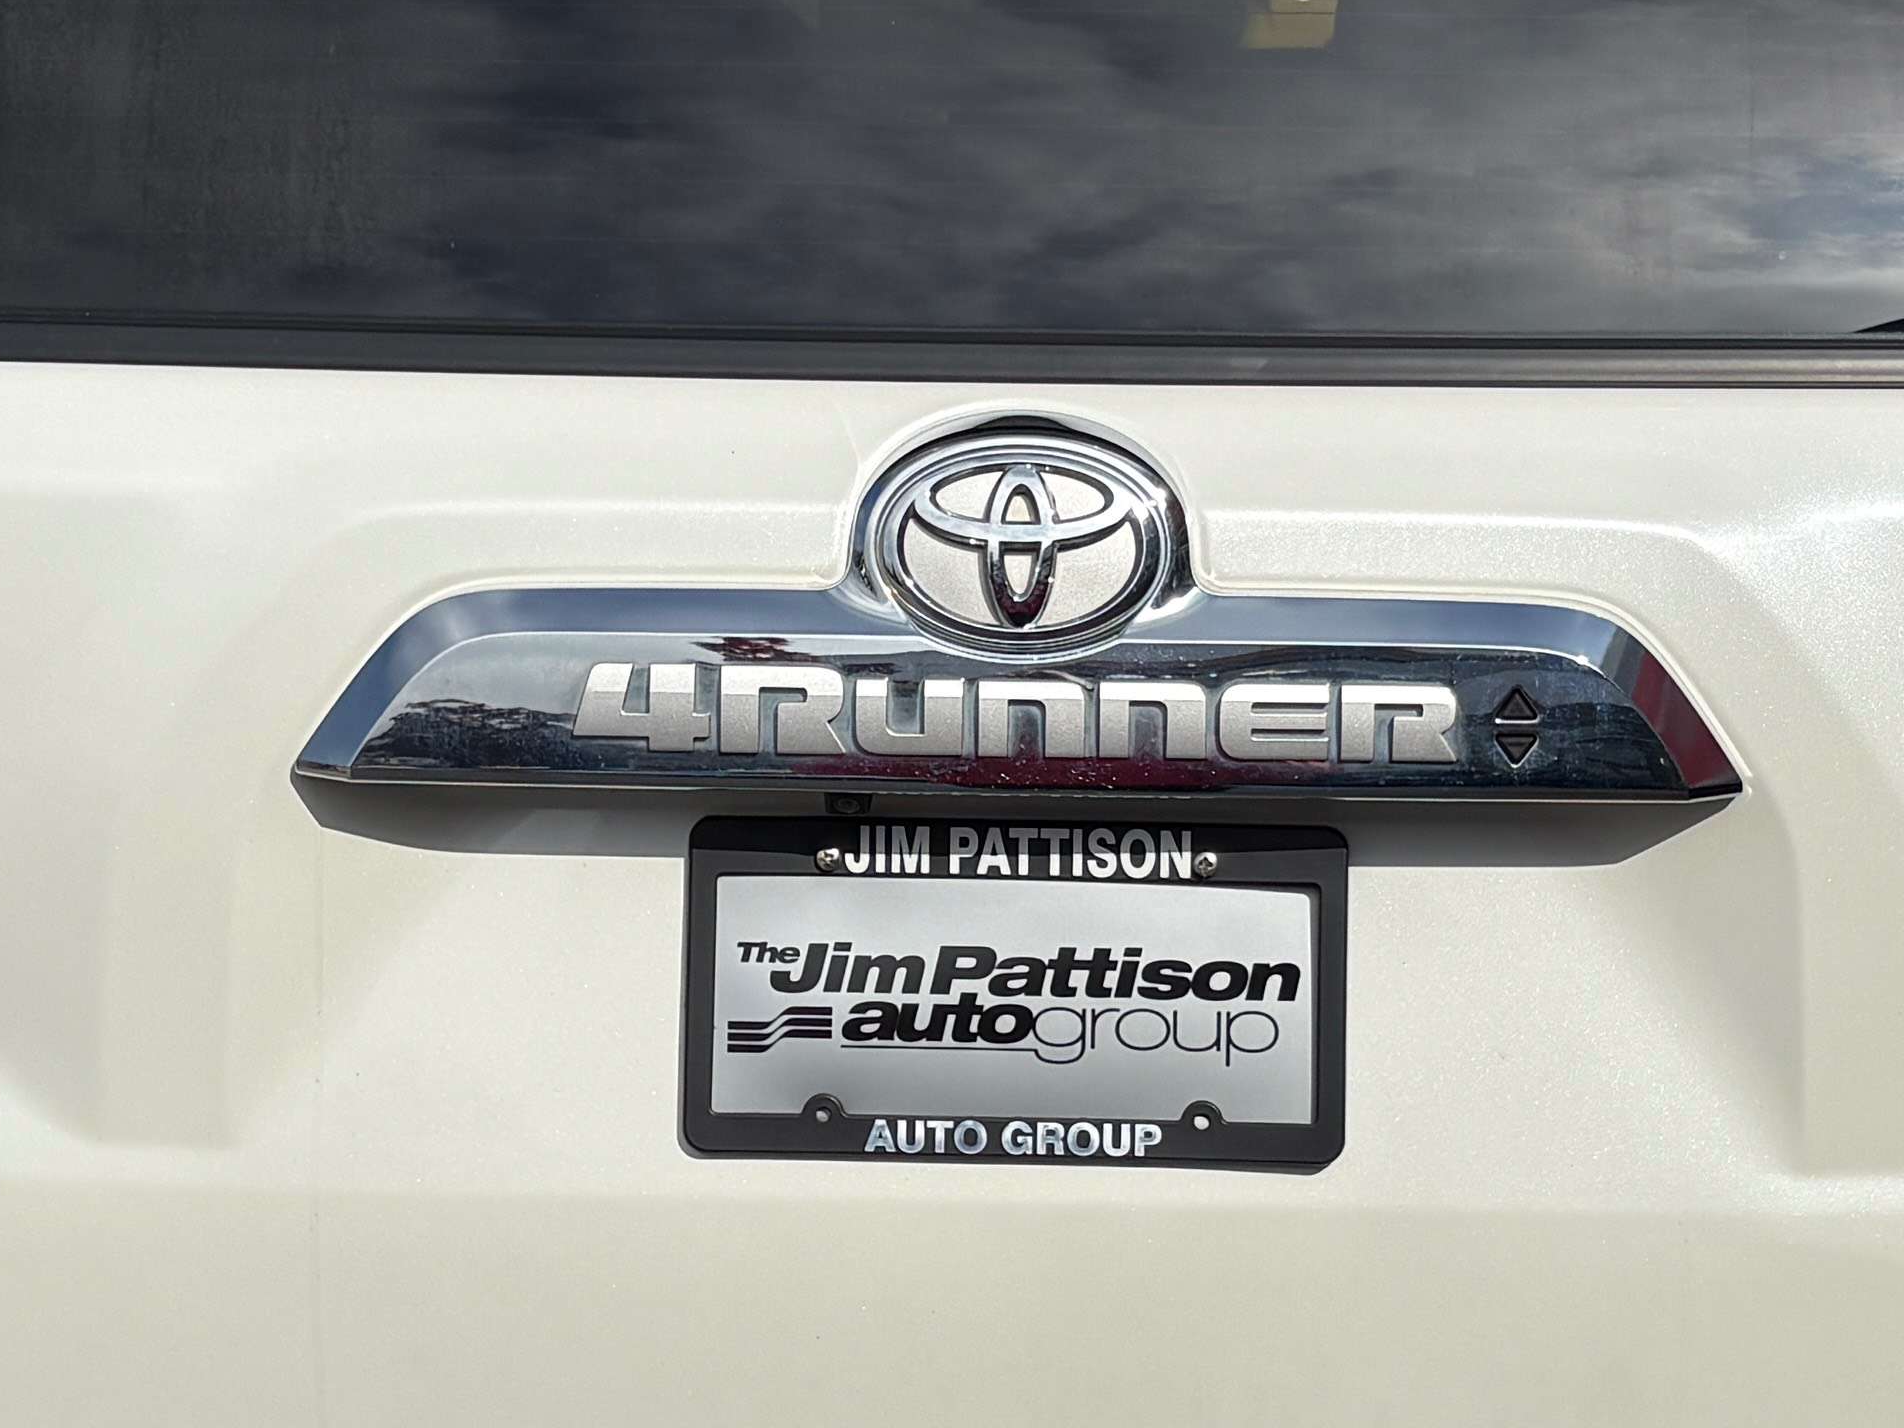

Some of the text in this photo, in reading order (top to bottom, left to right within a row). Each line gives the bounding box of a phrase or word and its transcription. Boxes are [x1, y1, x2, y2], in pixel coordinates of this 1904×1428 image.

[573, 663, 1458, 763] 4RUNNER
[845, 825, 1193, 880] JIM PATTISON
[737, 941, 1301, 1002] The Jim Pattison
[864, 1119, 1162, 1157] AUTO GROUP
